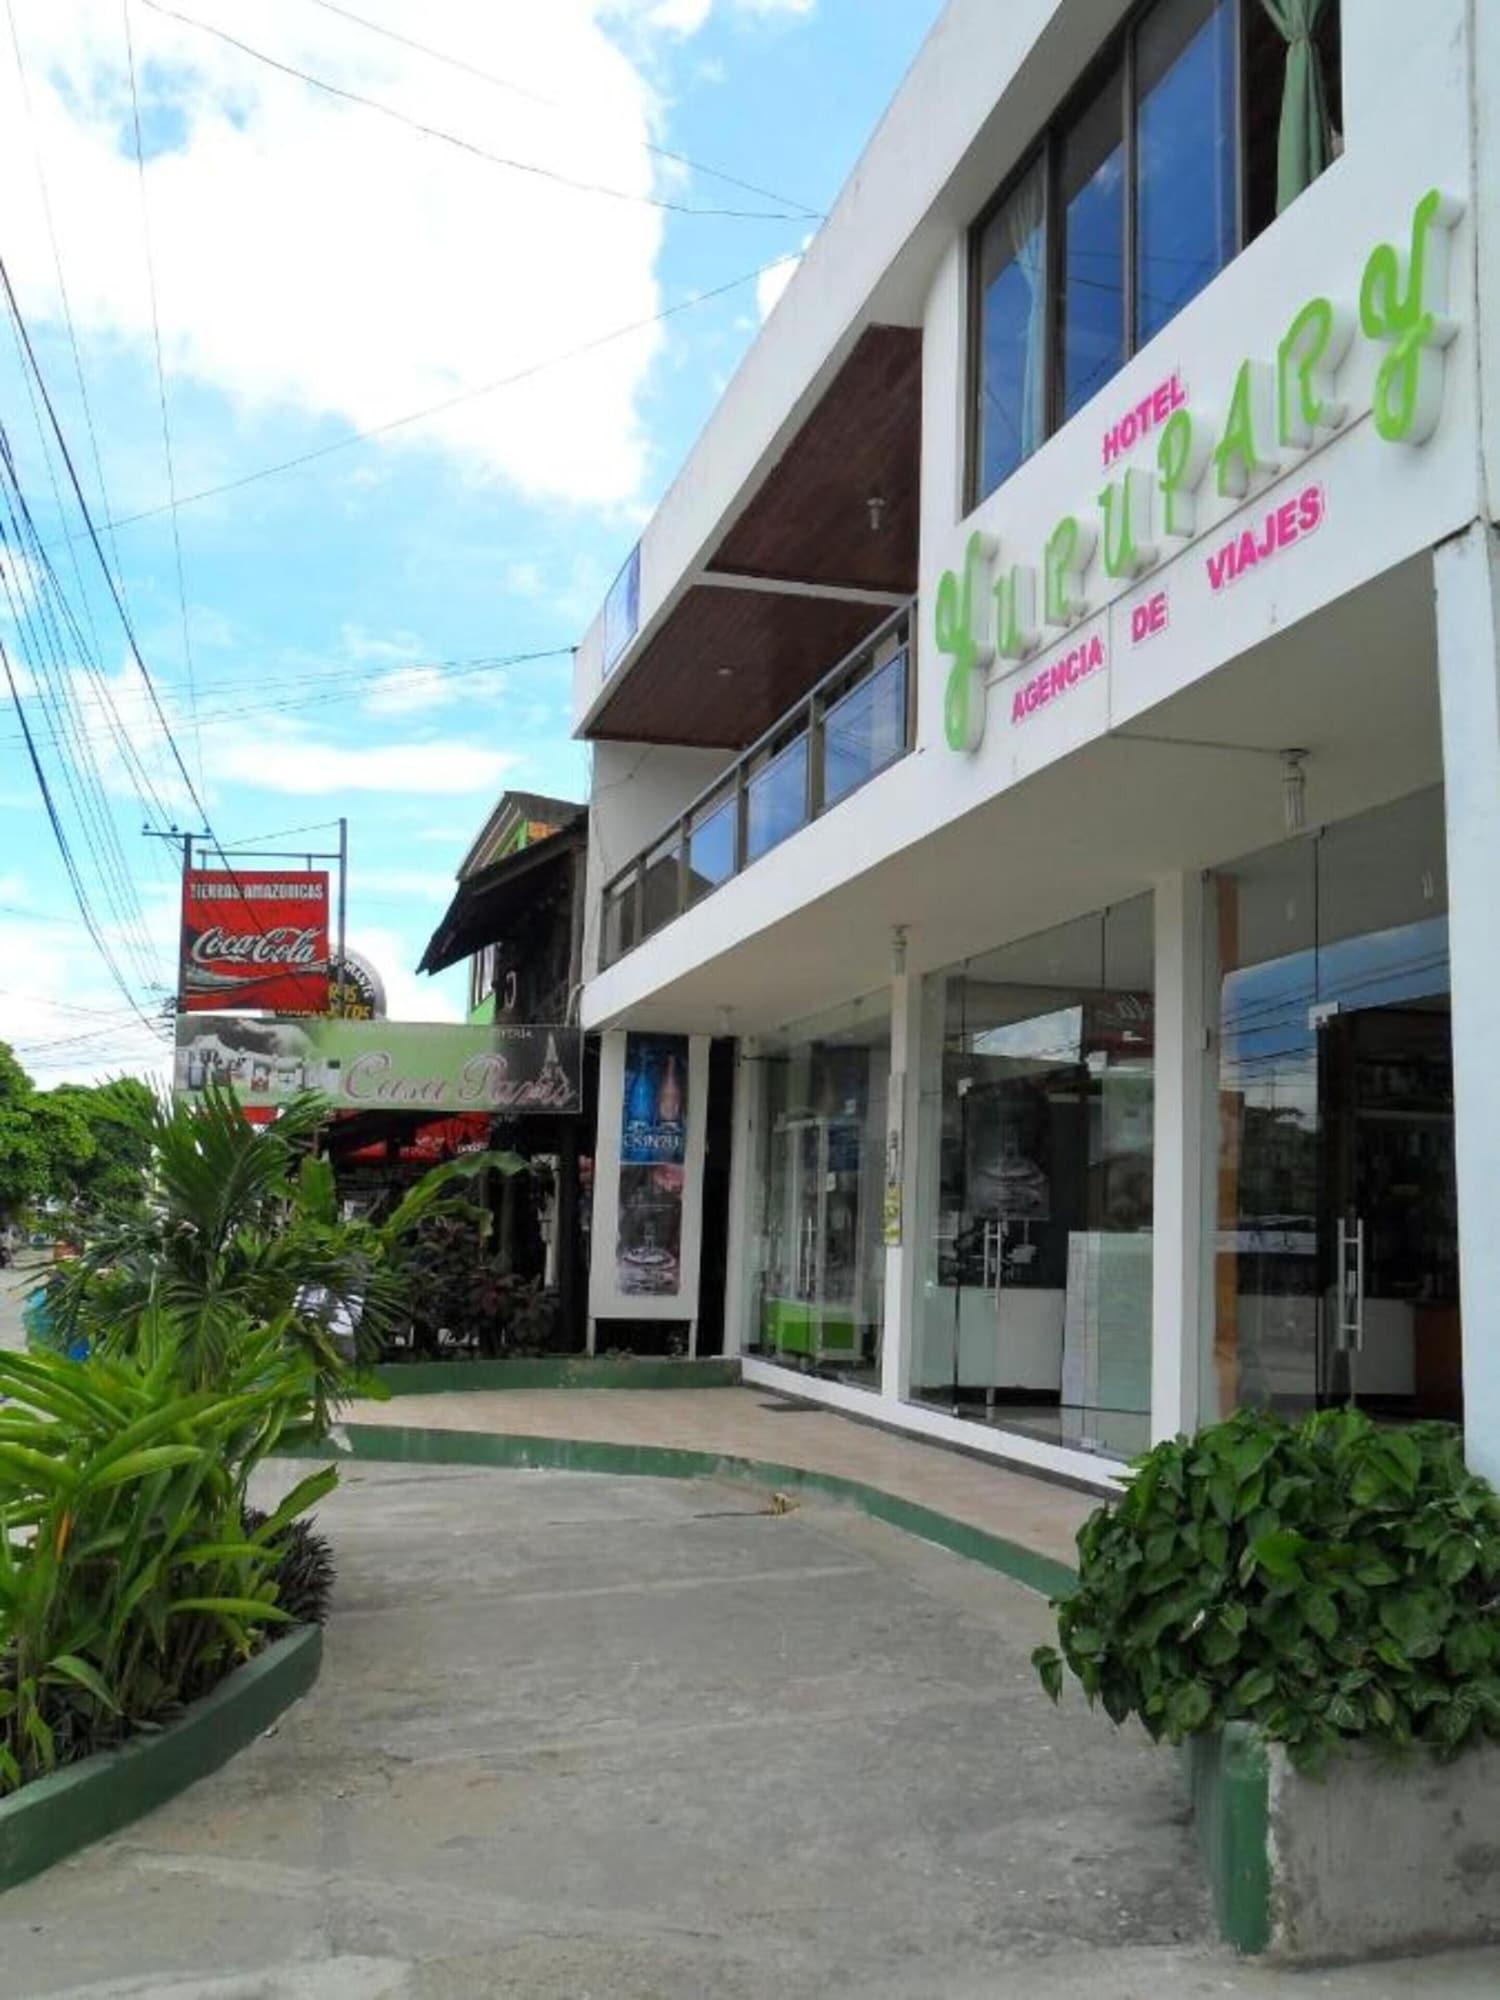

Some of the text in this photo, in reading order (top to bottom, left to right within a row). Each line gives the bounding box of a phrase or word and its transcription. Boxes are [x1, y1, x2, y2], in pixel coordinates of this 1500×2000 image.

[1102, 374, 1187, 467] HOTEL
[1011, 485, 1322, 725] AGENCIA DE VIAJES
[344, 1050, 448, 1102] Casa
